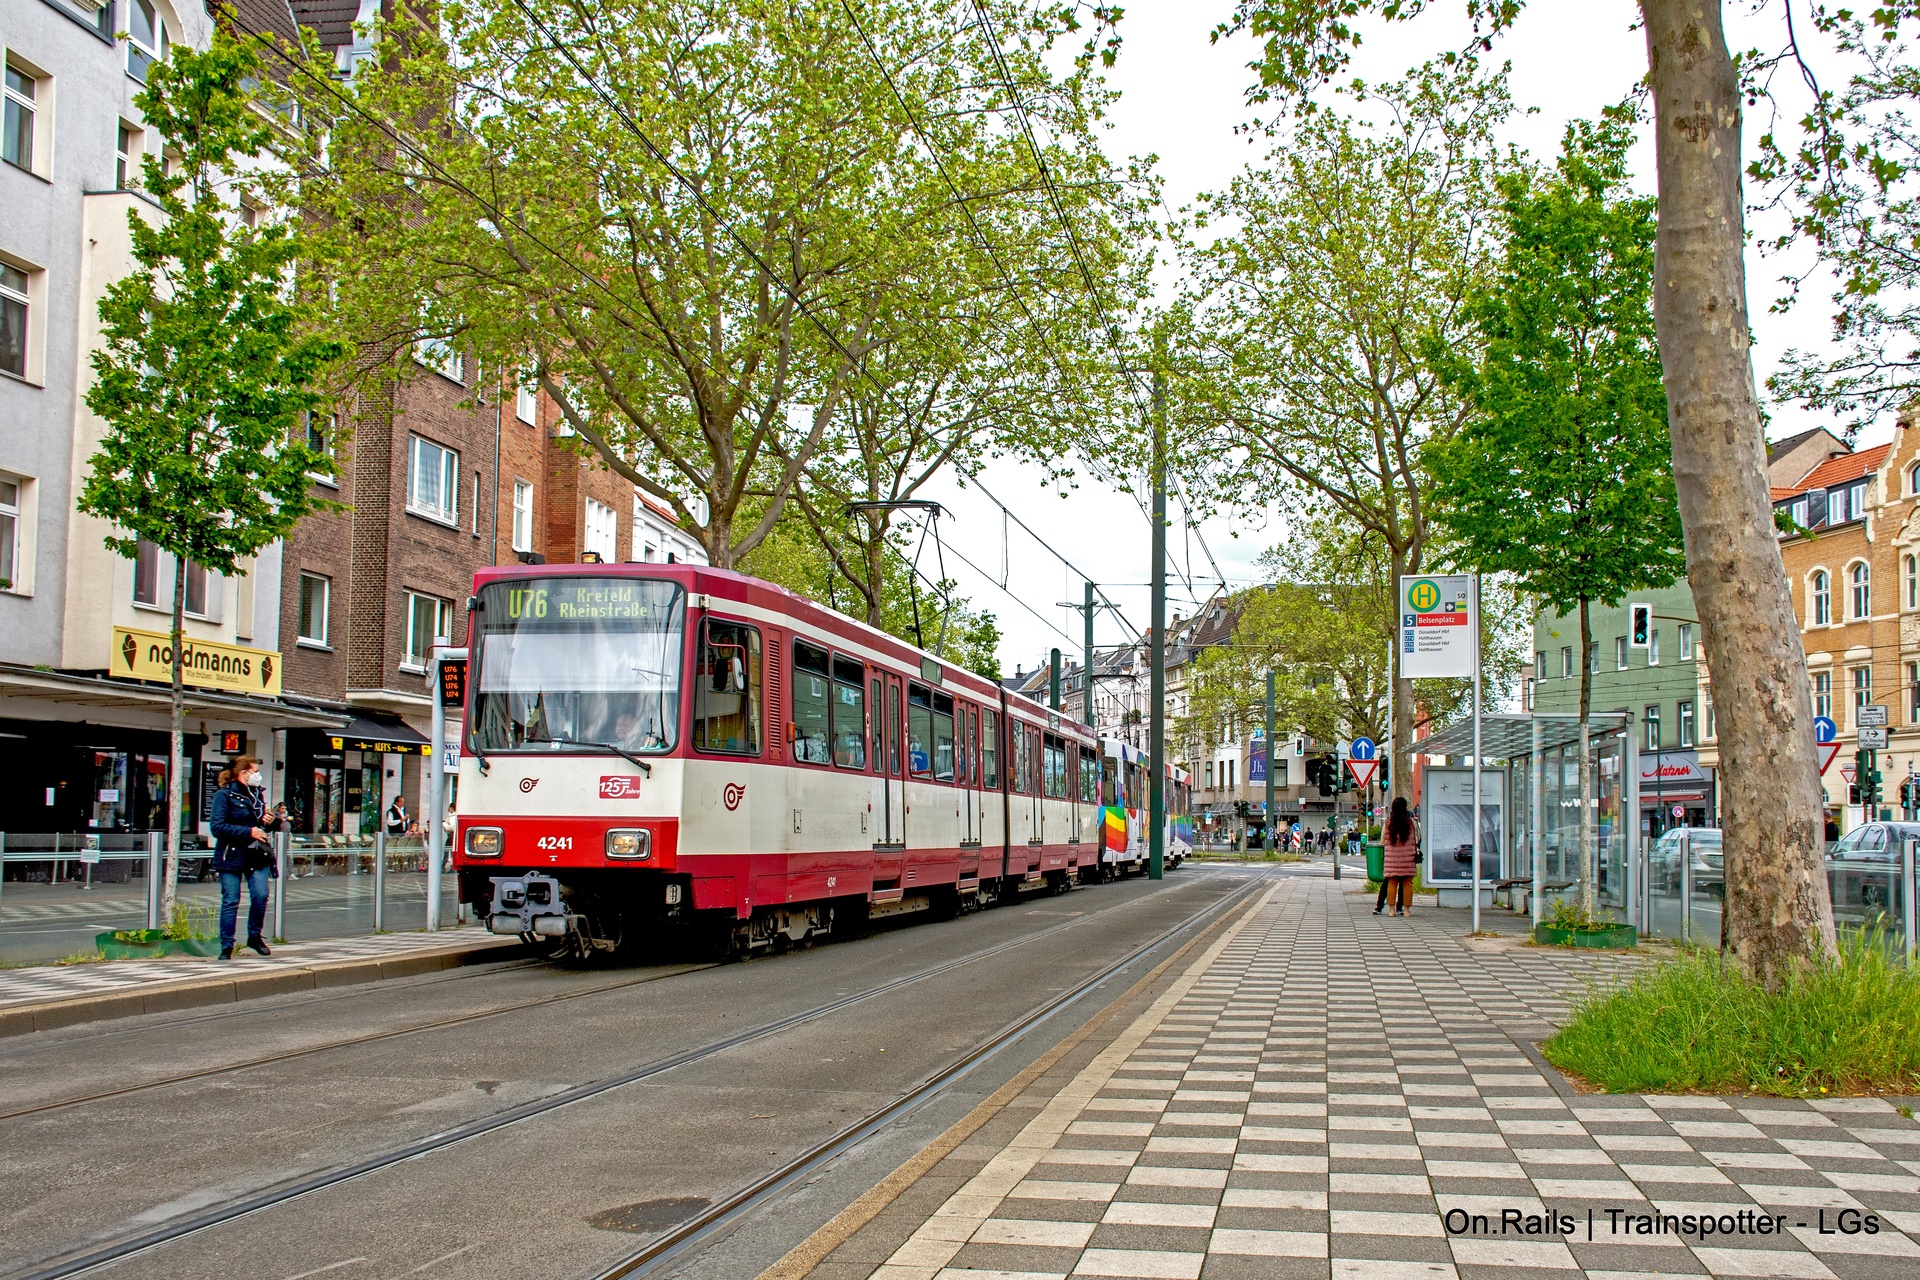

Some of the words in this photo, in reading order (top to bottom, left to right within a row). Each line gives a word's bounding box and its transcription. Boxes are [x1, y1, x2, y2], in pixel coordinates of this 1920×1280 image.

[577, 588, 632, 603] Krefeld
[509, 589, 548, 618] U76
[559, 602, 648, 618] Rheinstraße
[1406, 615, 1413, 626] 5
[1418, 616, 1455, 624] Belsenplatz
[149, 643, 251, 676] nodmanns
[600, 781, 621, 793] 125
[537, 836, 573, 850] 4241
